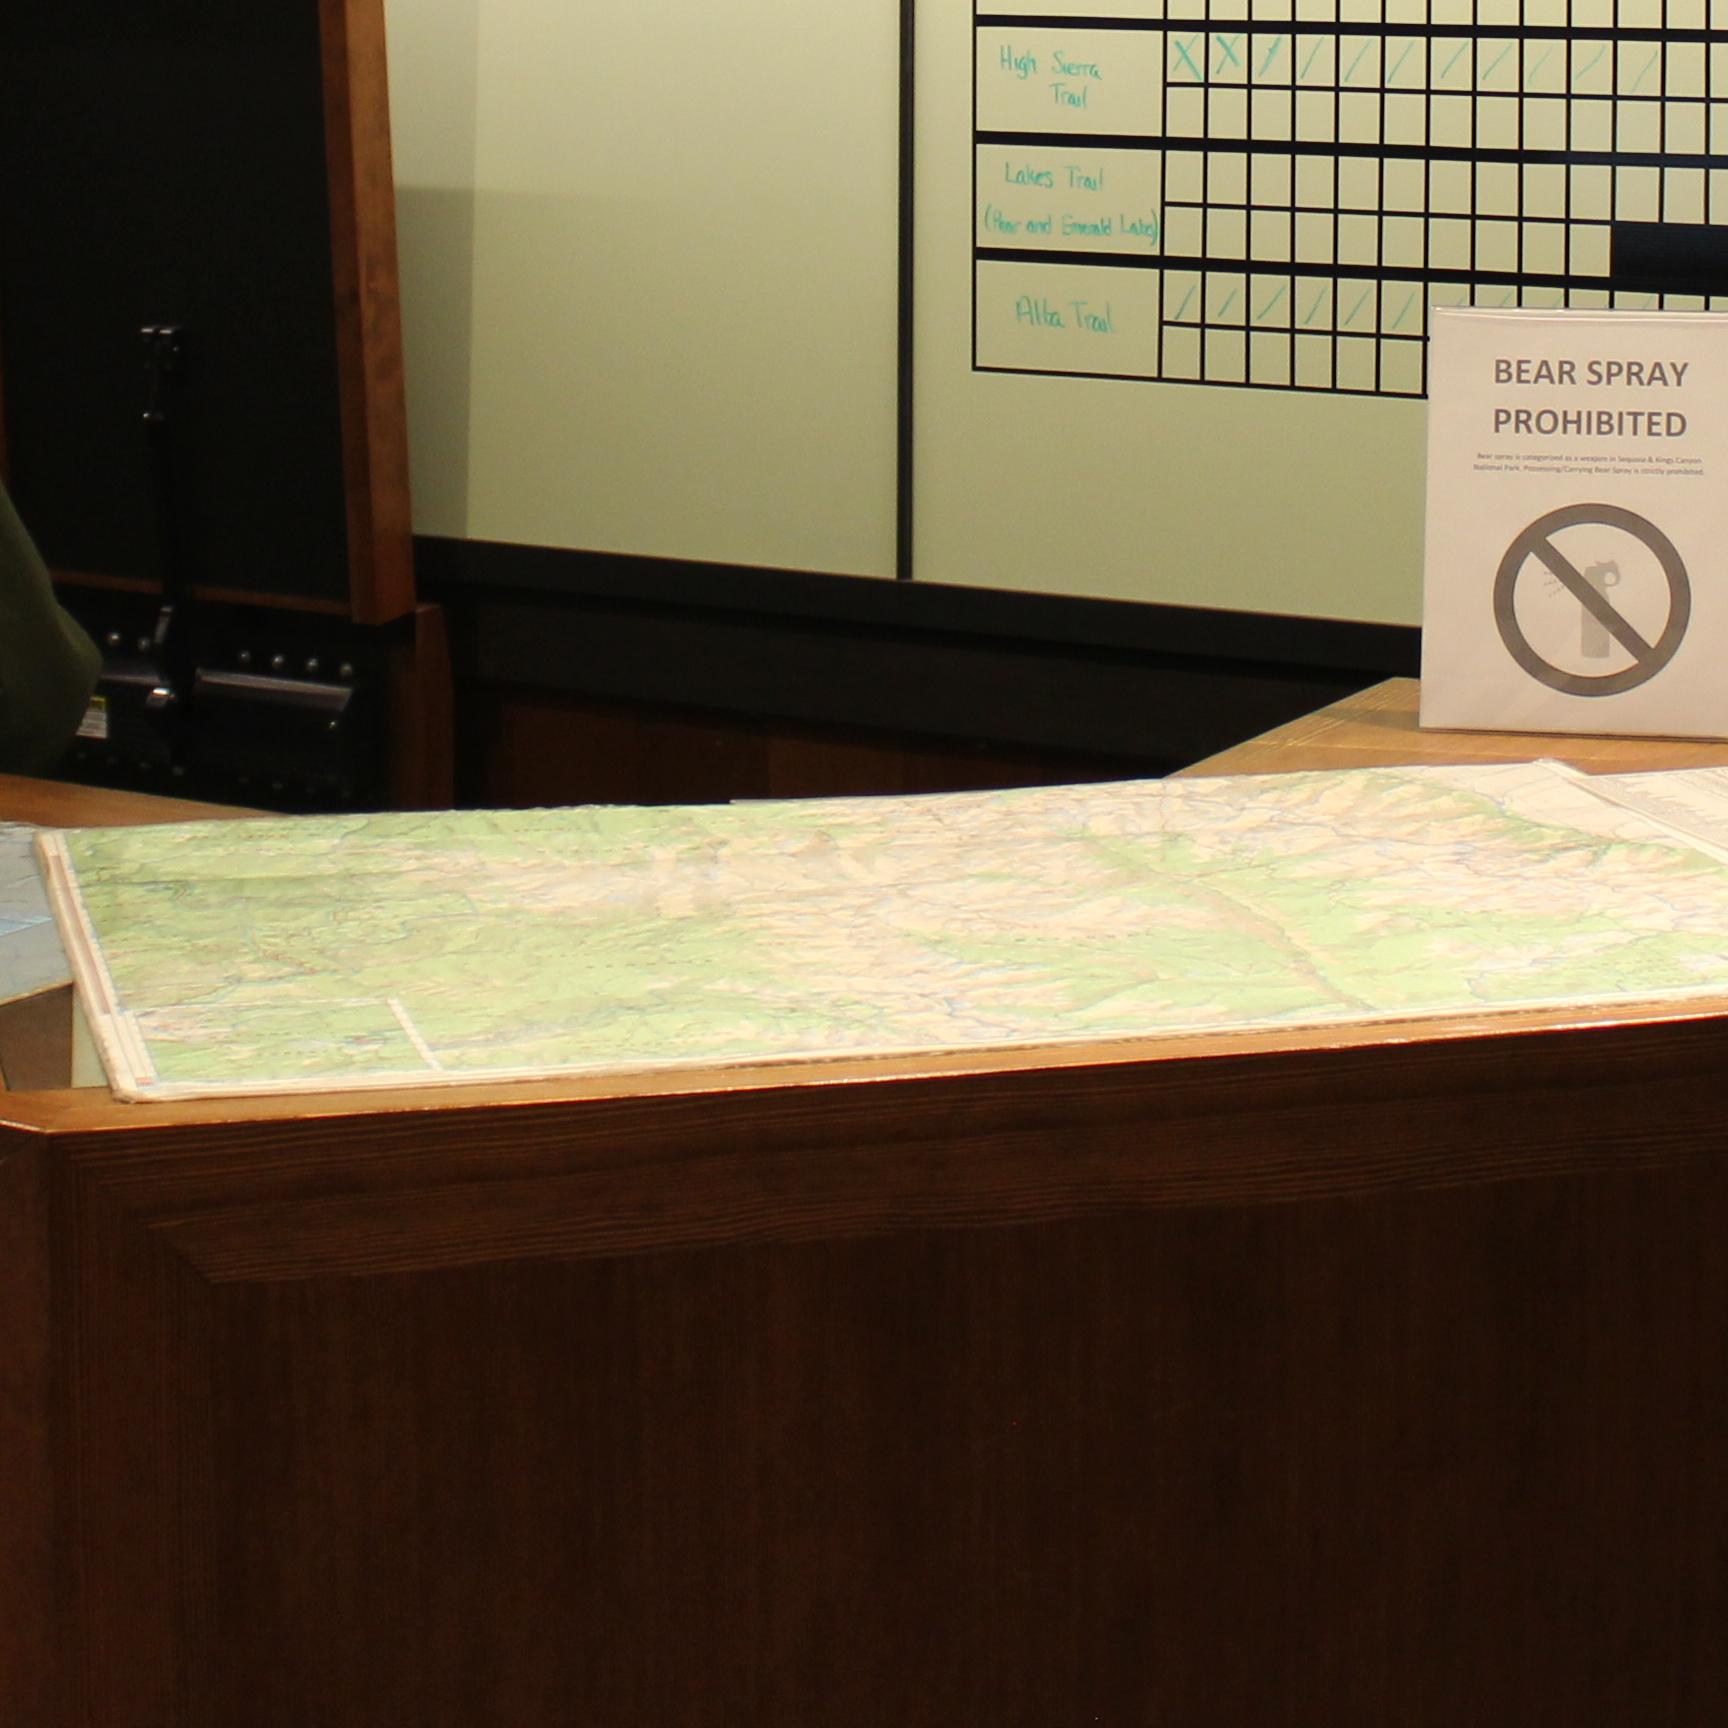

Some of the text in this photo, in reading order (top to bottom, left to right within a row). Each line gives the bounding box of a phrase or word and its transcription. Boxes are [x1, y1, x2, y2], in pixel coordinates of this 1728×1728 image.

[1000, 45, 1103, 80] High Sierra
[1049, 83, 1089, 108] Trail
[1005, 162, 1103, 191] Lakes Trail
[1027, 214, 1051, 232] and
[1068, 301, 1112, 333] Trail
[1494, 359, 1689, 387] BEAR SPRAY
[1493, 409, 1687, 437] PROHIBITED
